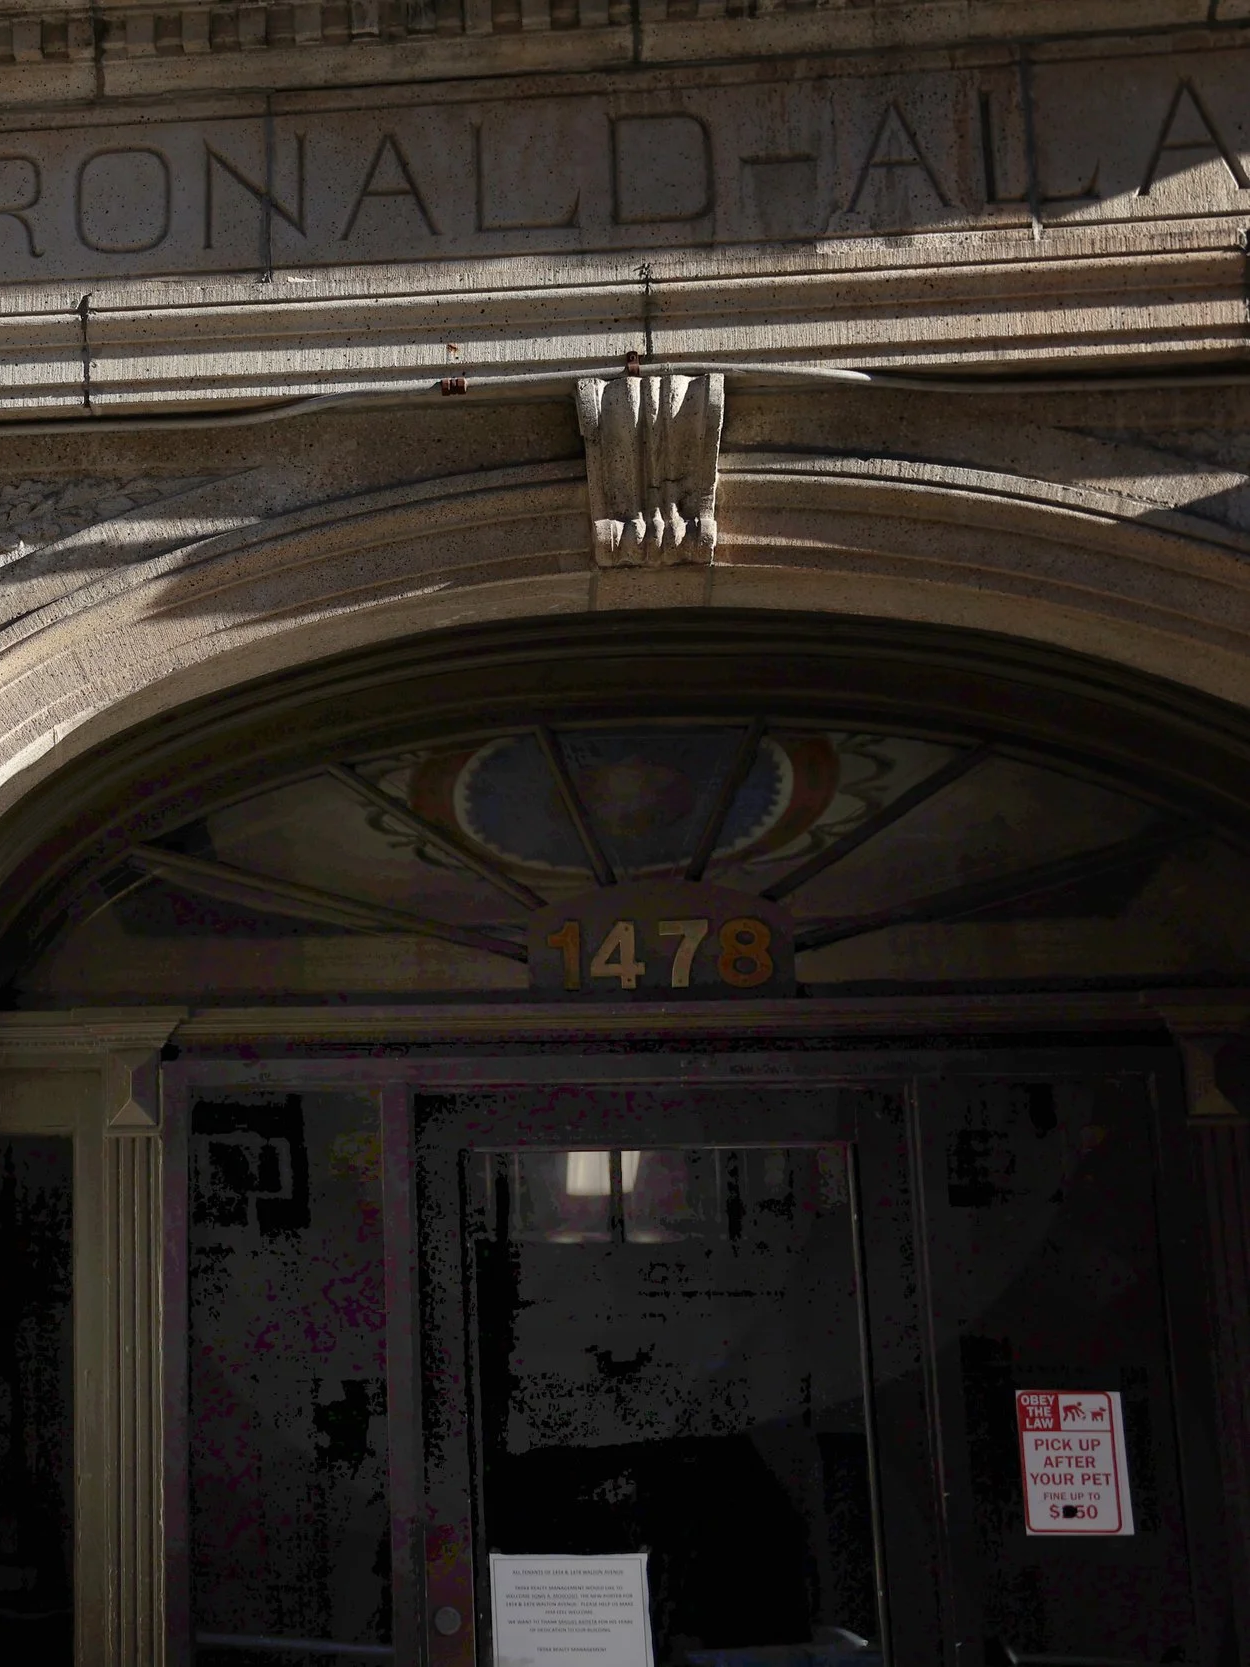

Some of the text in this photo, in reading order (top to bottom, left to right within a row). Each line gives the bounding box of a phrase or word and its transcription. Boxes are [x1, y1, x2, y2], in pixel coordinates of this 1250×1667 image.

[547, 918, 773, 991] 1478
[1021, 1395, 1055, 1406] OBEY
[1026, 1406, 1052, 1417] THE
[1026, 1418, 1054, 1429] LAW
[1034, 1438, 1101, 1452] PICK UP
[1043, 1455, 1096, 1469] AFTER
[1030, 1472, 1111, 1487] YOUR PET
[1043, 1491, 1101, 1501] FINE UP TO
[1049, 1503, 1098, 1520] $50
